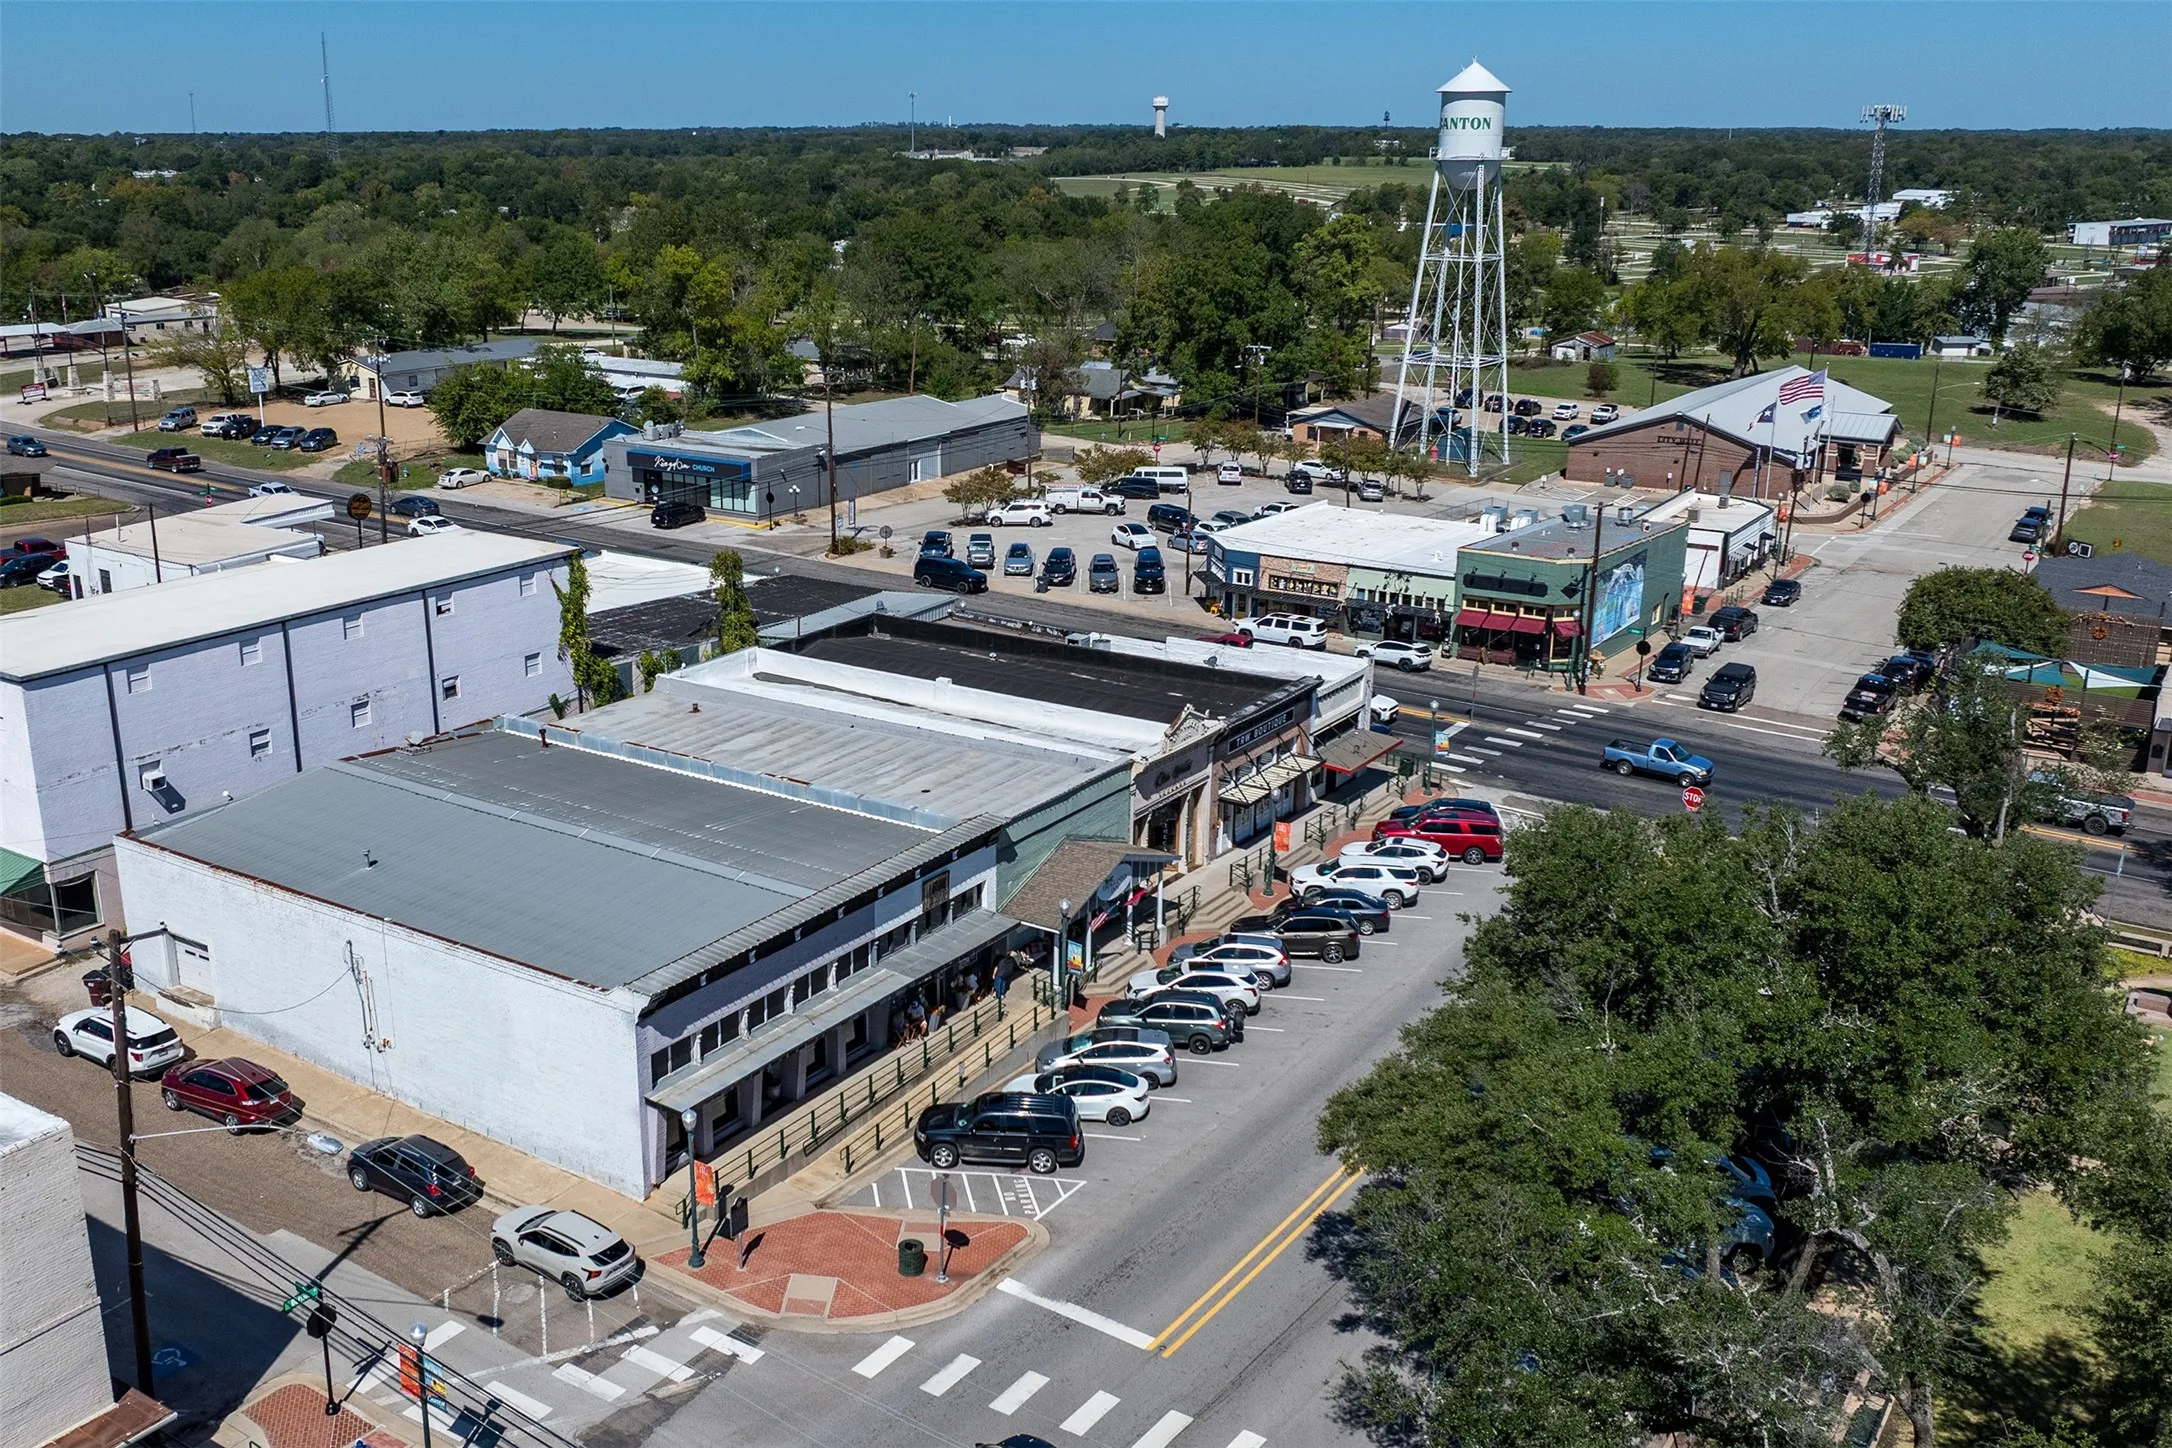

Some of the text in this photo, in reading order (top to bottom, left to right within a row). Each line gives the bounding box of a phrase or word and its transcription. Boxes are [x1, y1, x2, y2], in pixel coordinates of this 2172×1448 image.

[1440, 116, 1492, 130] ANTON
[654, 455, 716, 473] Kingdom CHURCH
[1236, 713, 1287, 747] TRW BOUTIQUE
[1003, 1191, 1016, 1201] NO
[1013, 1178, 1036, 1214] PARKING
